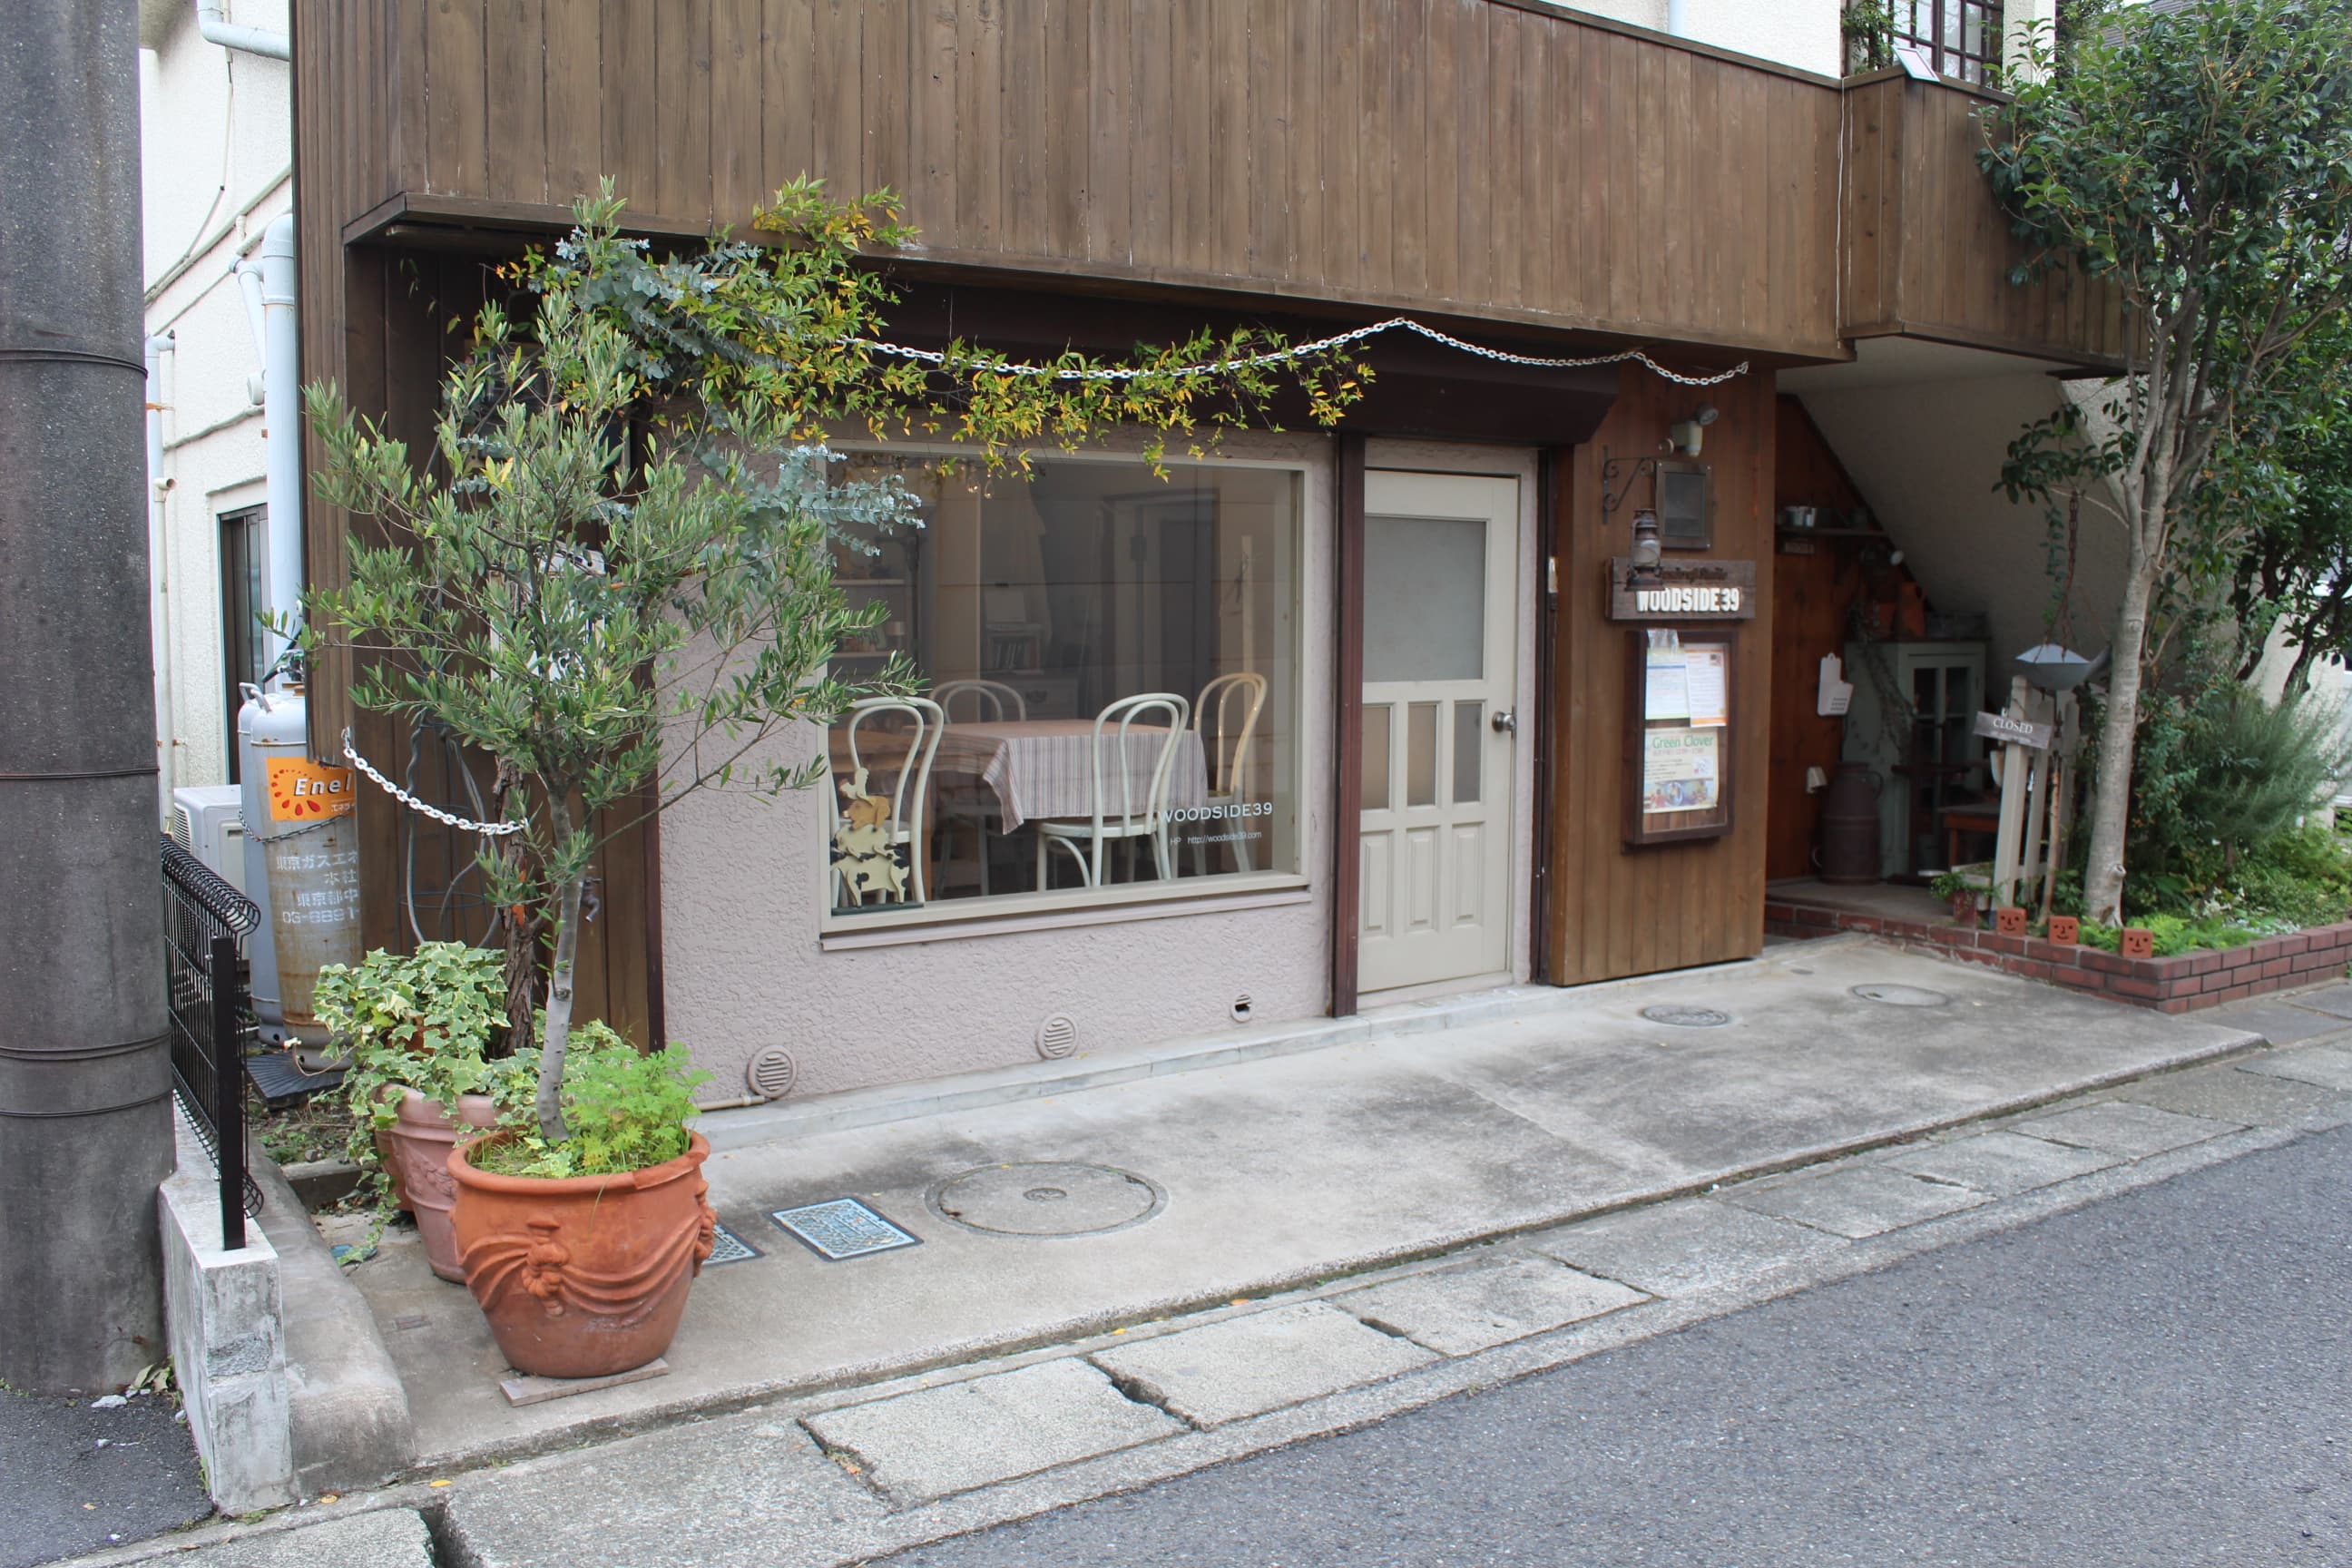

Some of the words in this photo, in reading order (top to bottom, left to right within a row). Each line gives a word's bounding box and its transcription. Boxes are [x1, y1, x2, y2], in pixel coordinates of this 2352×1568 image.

[1636, 587, 1740, 612] WOODSIDE39
[1993, 717, 2034, 734] CLOSED
[1651, 736, 1681, 750] Green
[1683, 733, 1714, 749] Clover
[1158, 802, 1272, 823] WOODSIDE39
